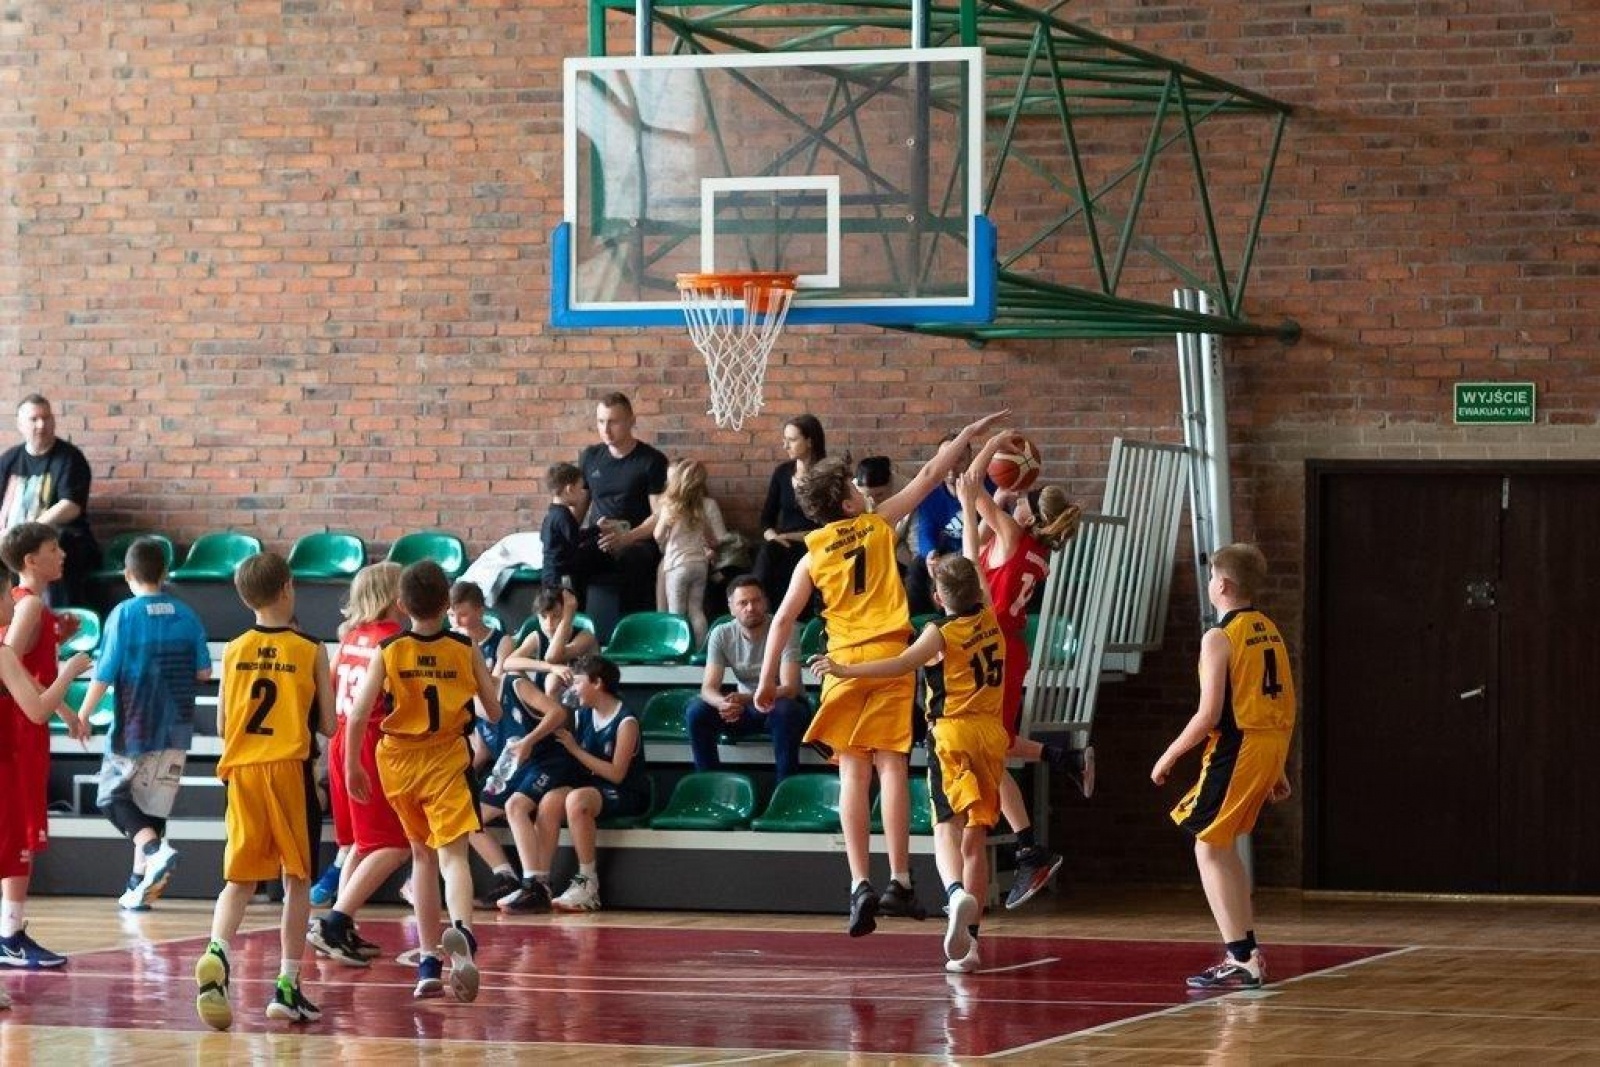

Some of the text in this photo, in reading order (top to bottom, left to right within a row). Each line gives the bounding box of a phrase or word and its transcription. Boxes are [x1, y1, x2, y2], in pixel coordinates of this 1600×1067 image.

[1458, 407, 1531, 416] EWAKUACYJNE
[1462, 389, 1528, 404] WYJŚCIE
[843, 544, 867, 595] 7
[257, 647, 278, 659] MKS
[970, 642, 1004, 688] 15
[1262, 648, 1283, 700] 4
[245, 677, 278, 736] 2
[423, 684, 440, 732] 1
